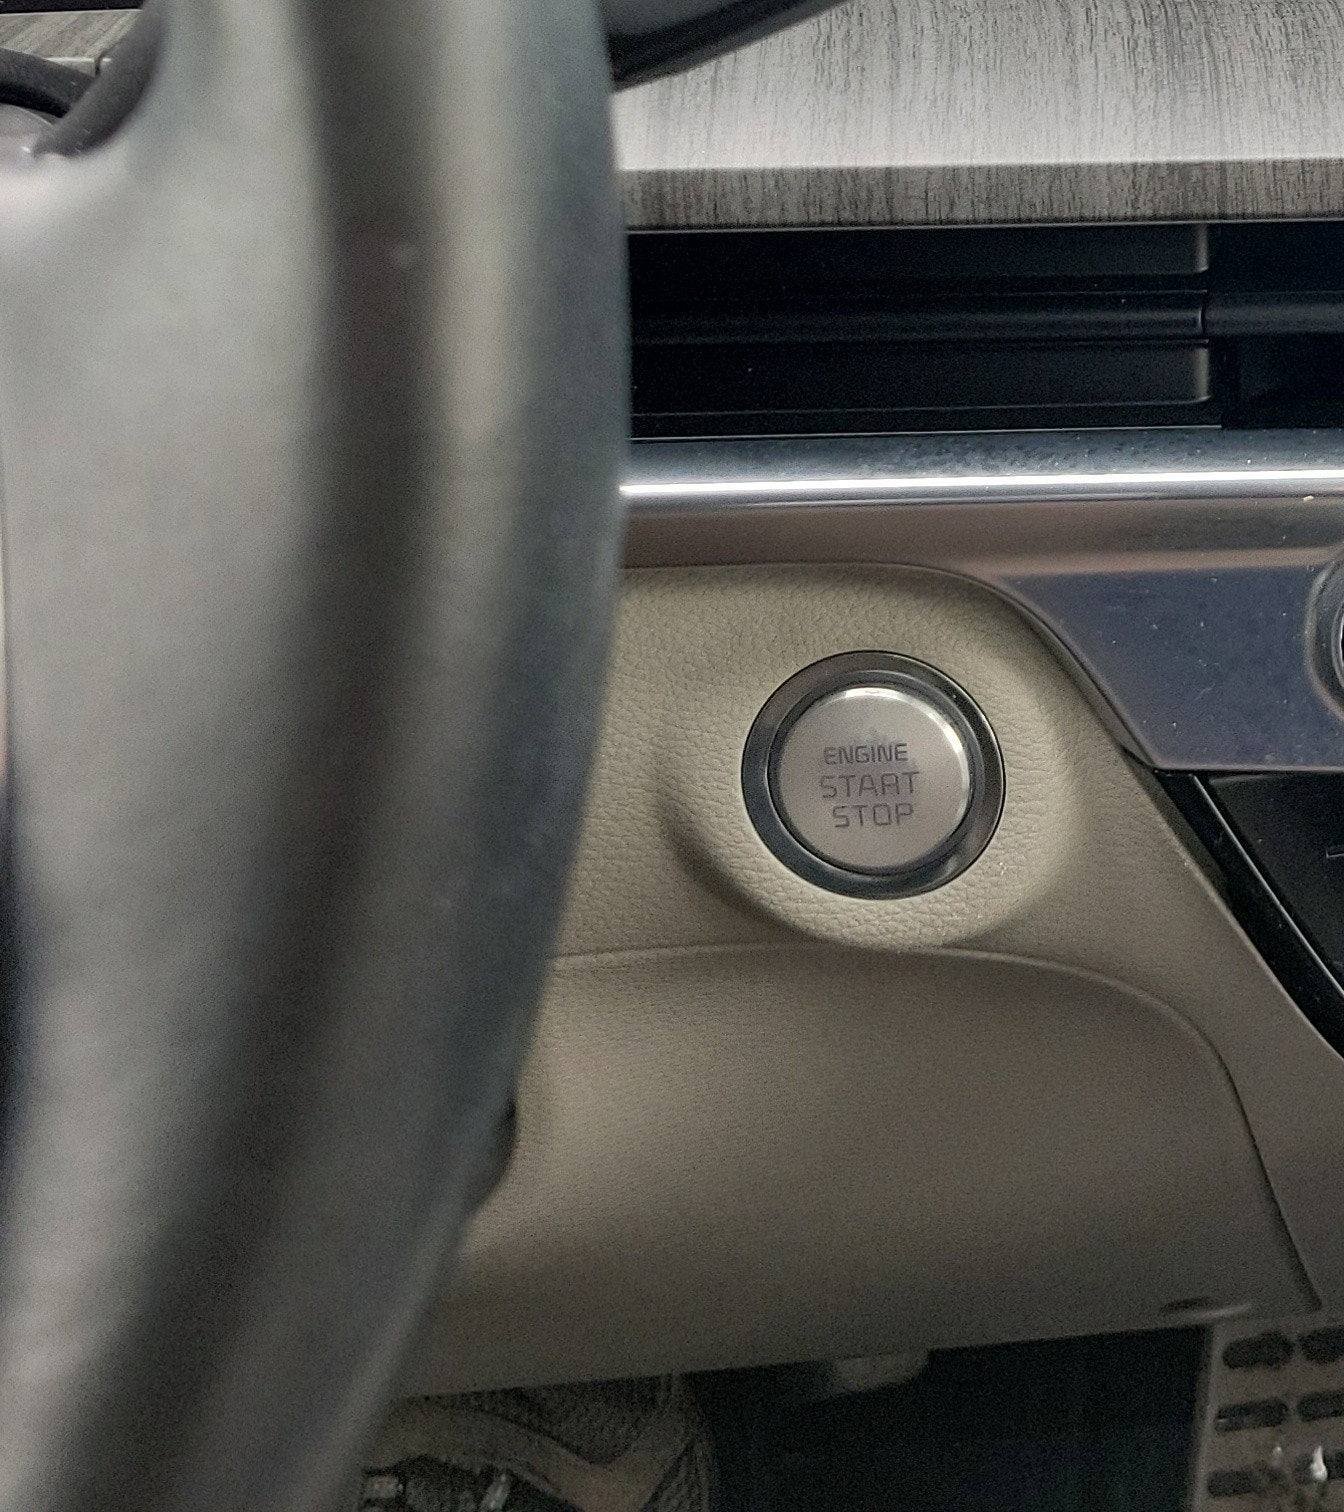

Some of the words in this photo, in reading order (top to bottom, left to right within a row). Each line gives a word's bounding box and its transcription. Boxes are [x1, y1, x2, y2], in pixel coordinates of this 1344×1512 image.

[823, 743, 908, 765] ENGINE
[820, 771, 920, 799] START
[832, 803, 915, 828] STOP
